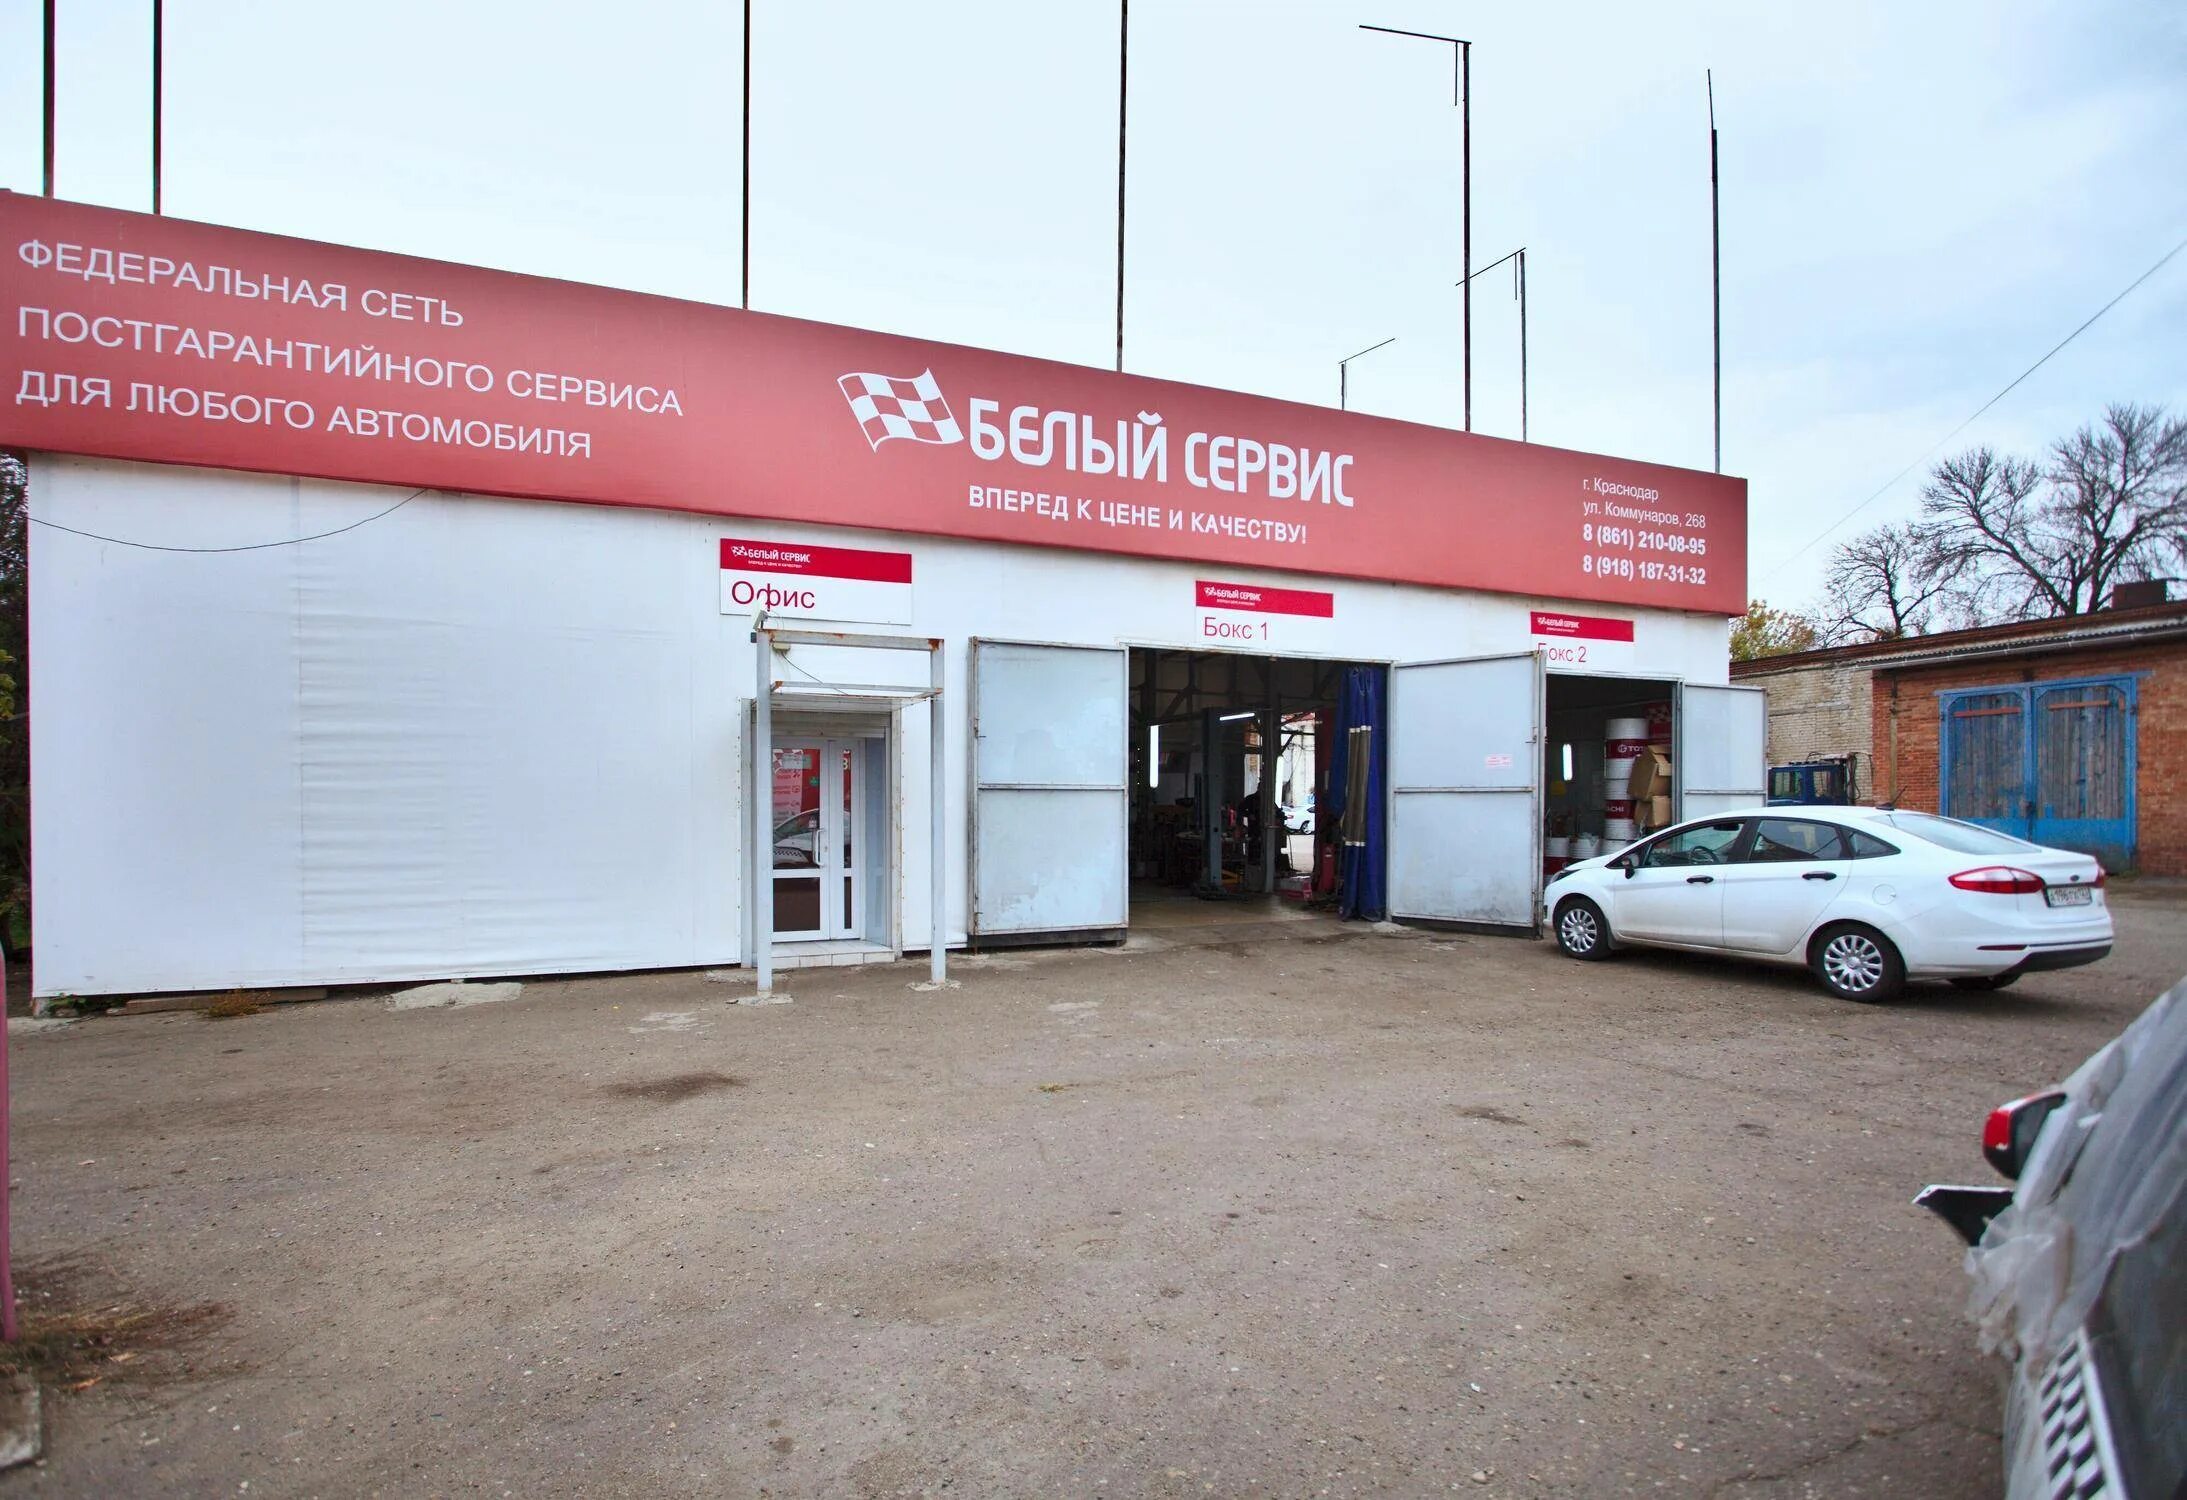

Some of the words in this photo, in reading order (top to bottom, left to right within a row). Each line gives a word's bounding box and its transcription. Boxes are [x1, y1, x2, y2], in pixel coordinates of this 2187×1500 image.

[18, 239, 347, 311] ФЕДЕРАЛЬНАЯ
[361, 289, 464, 327] СЕТЬ
[18, 306, 494, 393] ПОСТГАРАНТИЙНОГО
[506, 369, 684, 417] СЕРВИСА
[15, 370, 111, 408] ДЛЯ
[126, 382, 315, 429] ЛЮБОГО
[326, 405, 592, 459] АВТОМОБИЛЯ
[969, 397, 1168, 483] БЕЛЫЙ
[1184, 432, 1354, 507] СЕРВИС
[1583, 479, 1591, 491] г.
[1594, 477, 1659, 503] Краснодар
[969, 485, 1069, 522] ВПЕРЕД
[1077, 498, 1093, 520] К
[1100, 501, 1161, 529] ЦЕНЕ
[1168, 508, 1183, 530] И
[1191, 511, 1307, 545] КАЧЕСТВУ!
[1583, 501, 1602, 516] ул.
[1604, 501, 1682, 527] Коммунаров,
[1685, 512, 1706, 529] 268
[1583, 523, 1593, 542] 8
[1596, 525, 1635, 552] (861)
[1638, 530, 1706, 556] 210-08-95
[748, 548, 779, 561] БЕЛЫЙ
[780, 551, 811, 564] СЕРВИС
[1583, 554, 1593, 573] 8
[1596, 556, 1635, 582] (918)
[1638, 561, 1706, 585] 187-31-32
[731, 580, 816, 612] Офис
[1204, 616, 1253, 640] Бокс
[1260, 621, 1267, 641] 1
[1578, 645, 1587, 663] 2
